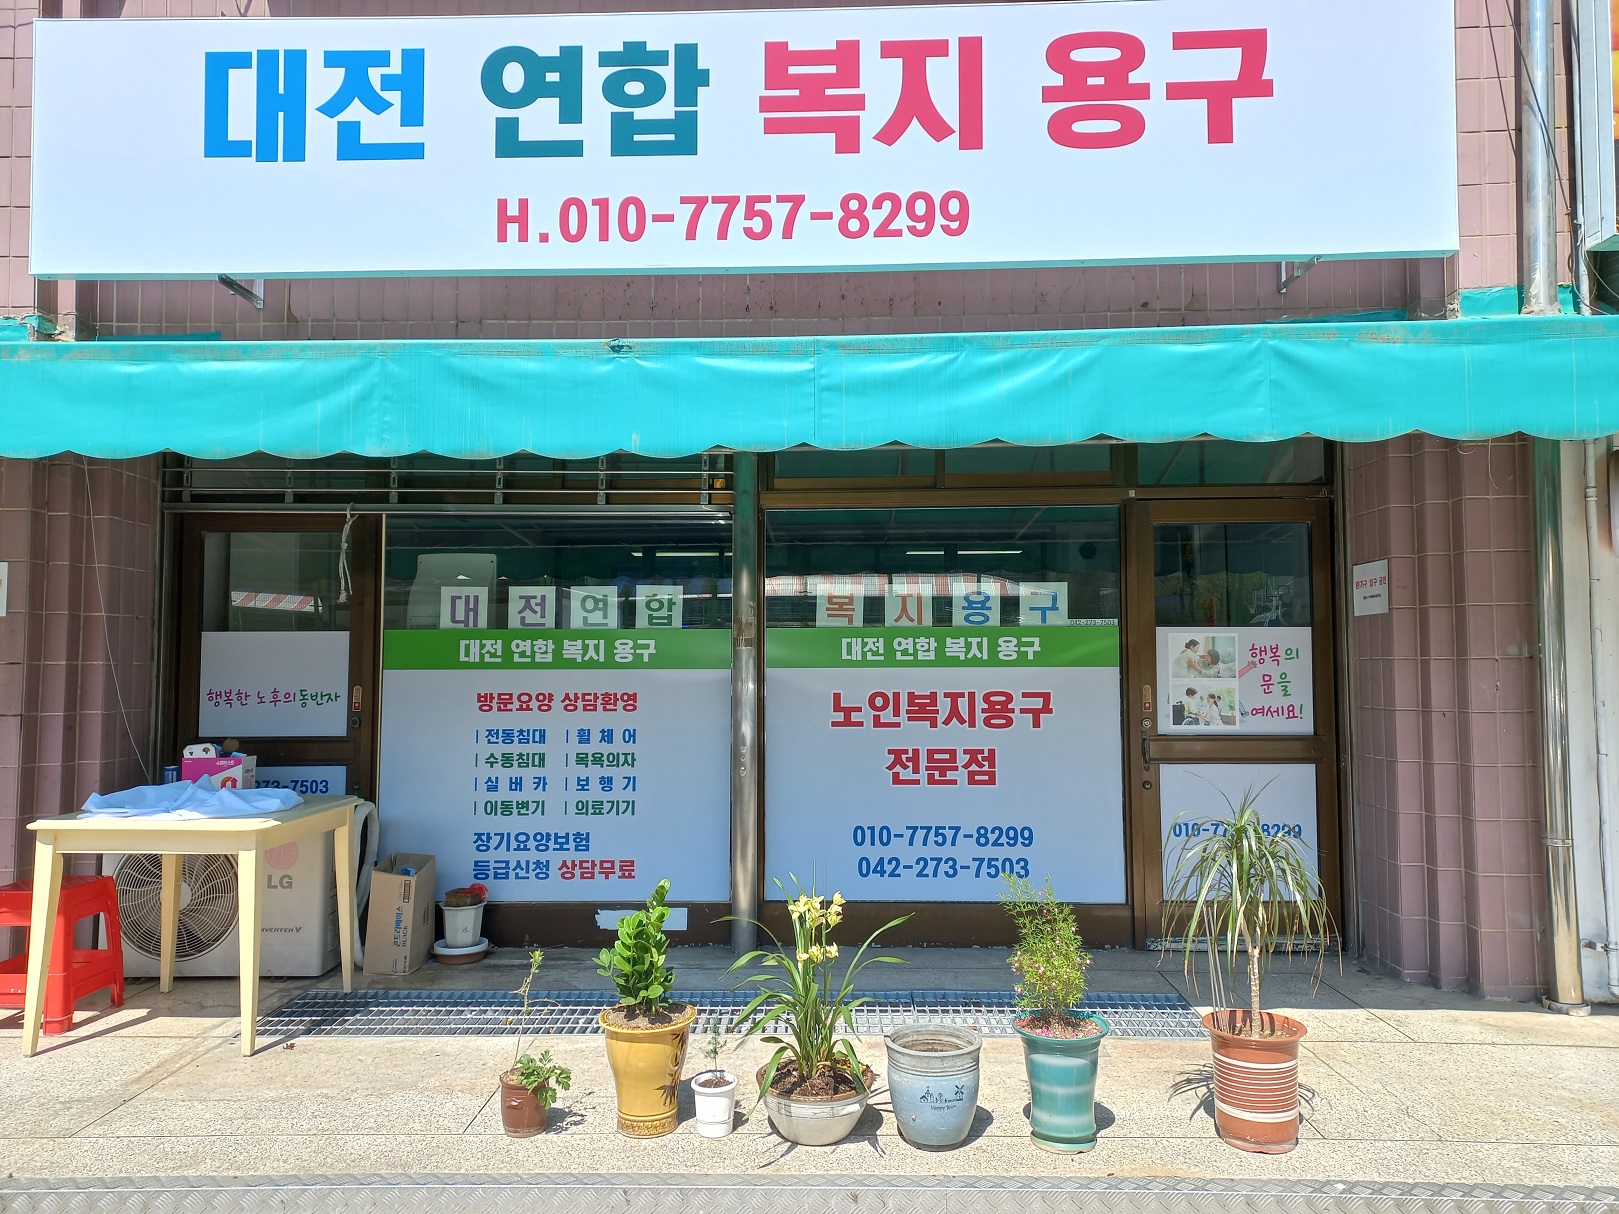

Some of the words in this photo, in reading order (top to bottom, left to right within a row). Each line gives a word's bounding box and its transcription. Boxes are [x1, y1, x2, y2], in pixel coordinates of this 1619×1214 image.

[204, 49, 425, 162] 대전
[481, 41, 710, 158] 연합
[759, 36, 984, 154] 복지
[1042, 28, 1274, 149] 용구
[497, 191, 969, 243] H.010-7757-8299
[459, 640, 501, 662] 대전
[511, 639, 555, 662] 연합
[562, 640, 605, 661] 복지
[613, 639, 657, 662] 용구
[841, 637, 885, 660] 대전
[893, 637, 937, 660] 연합
[945, 636, 988, 660] 복지
[997, 637, 1041, 660] 용구
[1260, 672, 1292, 697] 문을
[207, 688, 251, 708] 행복한
[477, 692, 553, 712] 방문요양
[560, 692, 638, 712] 상담환영
[830, 690, 1054, 729] 노인복지용구
[1250, 703, 1303, 720] 여세요!
[485, 728, 546, 745] 전동침대
[485, 752, 546, 769] 수동침대
[575, 752, 636, 769] 목욕의자
[886, 748, 997, 786] 전문점
[484, 800, 546, 817] 이동변기
[575, 800, 636, 816] 의료기기
[473, 831, 590, 853] 장기요양보험
[852, 825, 1034, 848] 010-7757-8299
[473, 859, 550, 881] 등급신청
[558, 859, 636, 881] 상담무료
[857, 857, 1030, 879] 042-273-7503
[267, 874, 293, 889] LG
